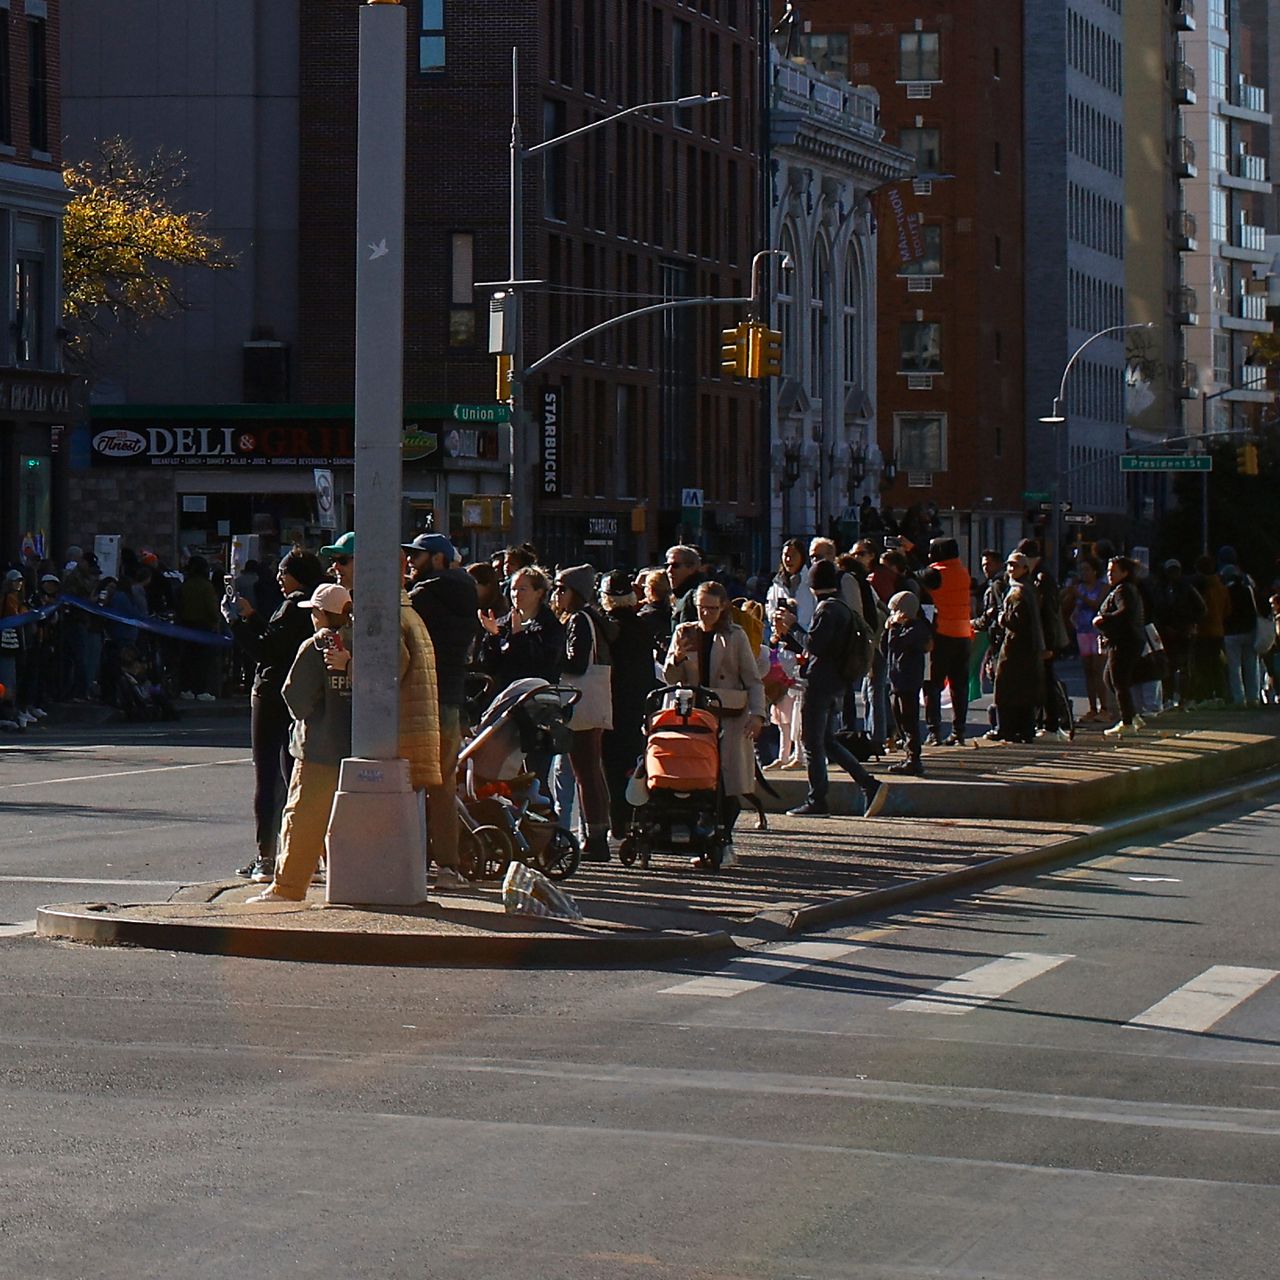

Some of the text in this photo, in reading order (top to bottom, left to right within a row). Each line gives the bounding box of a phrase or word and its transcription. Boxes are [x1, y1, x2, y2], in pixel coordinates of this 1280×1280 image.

[888, 189, 912, 261] MARTHON
[907, 212, 924, 256] ROUTE
[462, 407, 494, 420] Union
[145, 427, 237, 455] DELI
[240, 434, 254, 449] &
[262, 427, 353, 456] GRIL
[544, 393, 556, 493] STARBUCKS
[1131, 459, 1186, 468] President
